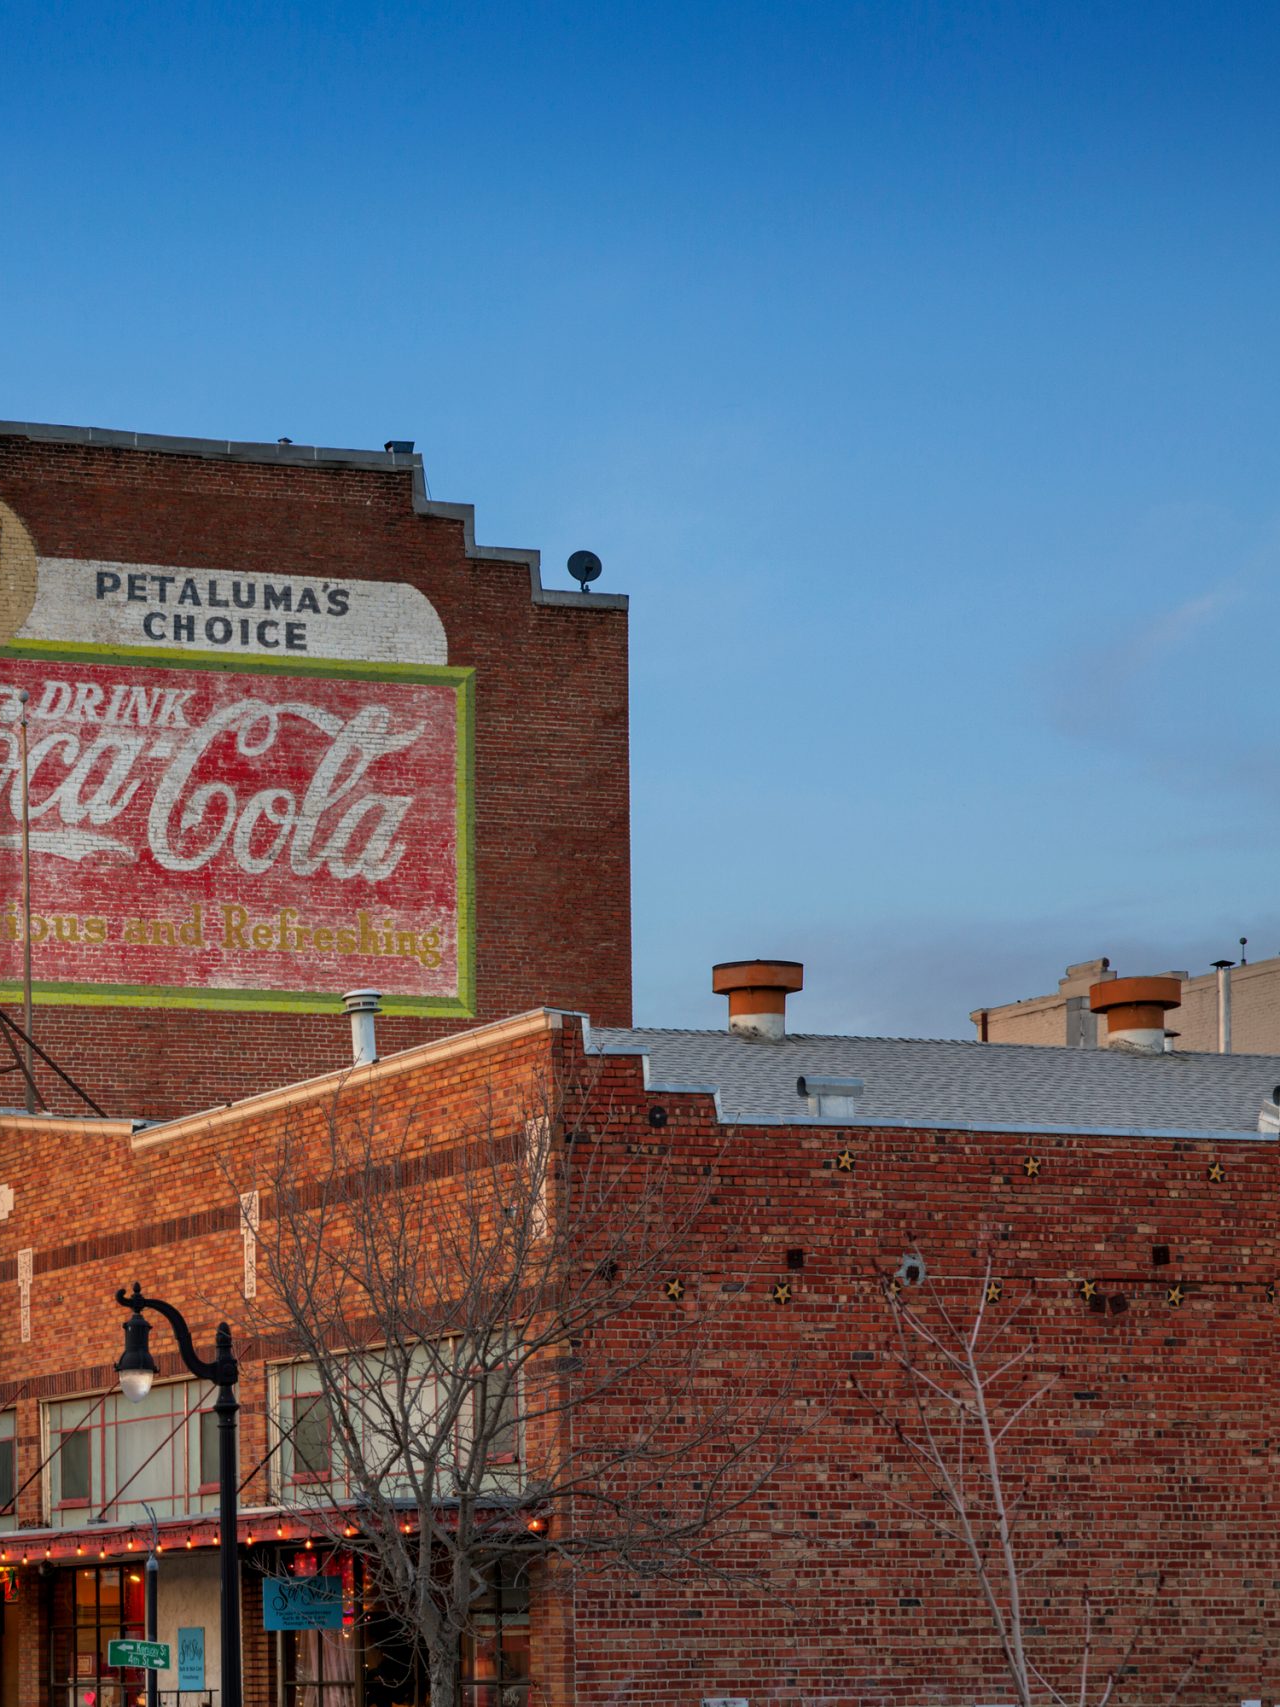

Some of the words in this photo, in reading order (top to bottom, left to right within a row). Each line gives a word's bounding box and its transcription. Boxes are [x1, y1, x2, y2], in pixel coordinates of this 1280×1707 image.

[95, 571, 350, 617] PETALUMA'S
[142, 611, 308, 650] CHOICE
[31, 680, 197, 729] DRINK
[124, 903, 206, 947] and
[220, 903, 442, 969] Refreshing
